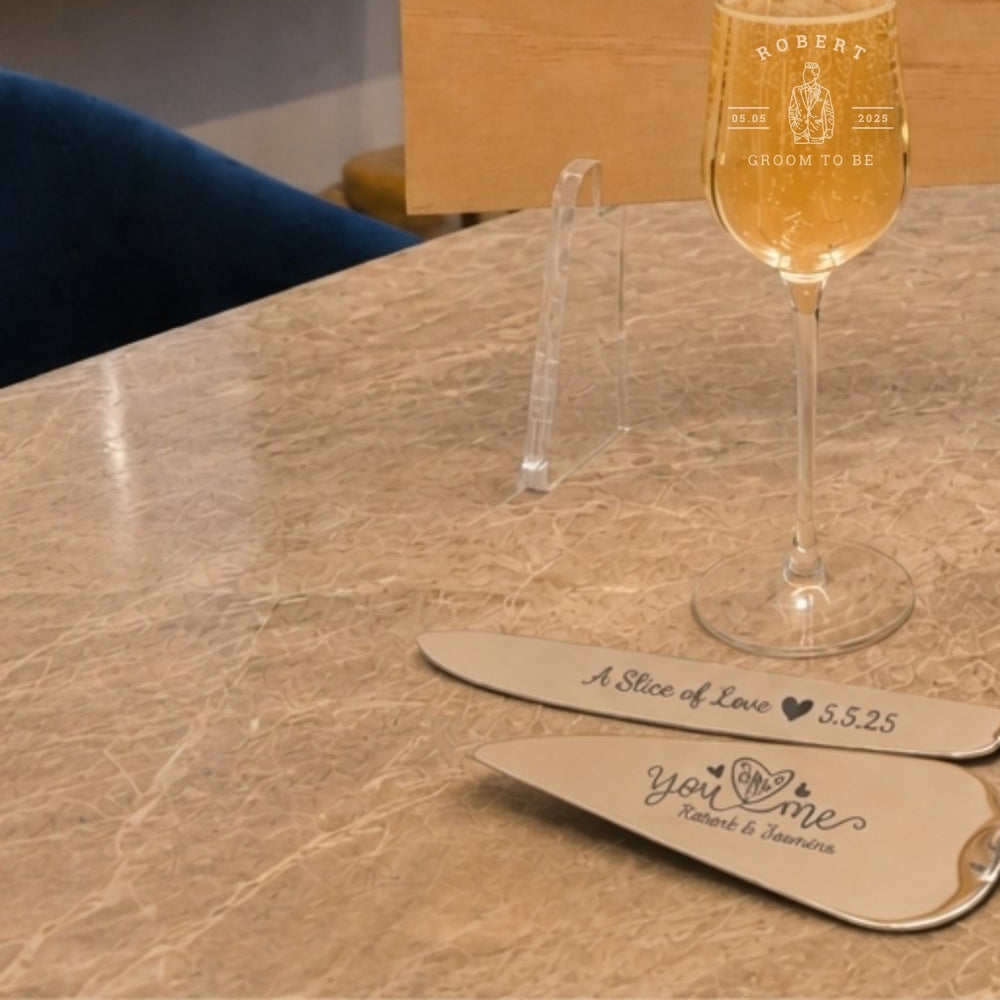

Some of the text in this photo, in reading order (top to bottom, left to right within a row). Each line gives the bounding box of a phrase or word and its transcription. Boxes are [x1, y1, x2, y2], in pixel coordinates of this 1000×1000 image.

[756, 34, 867, 62] ROBERT
[731, 113, 889, 123] 05.05 2025
[748, 154, 875, 167] GROOM TO BE
[582, 666, 898, 734] A Slice of Love 5.5.25
[644, 765, 728, 811] you
[776, 799, 866, 830] me
